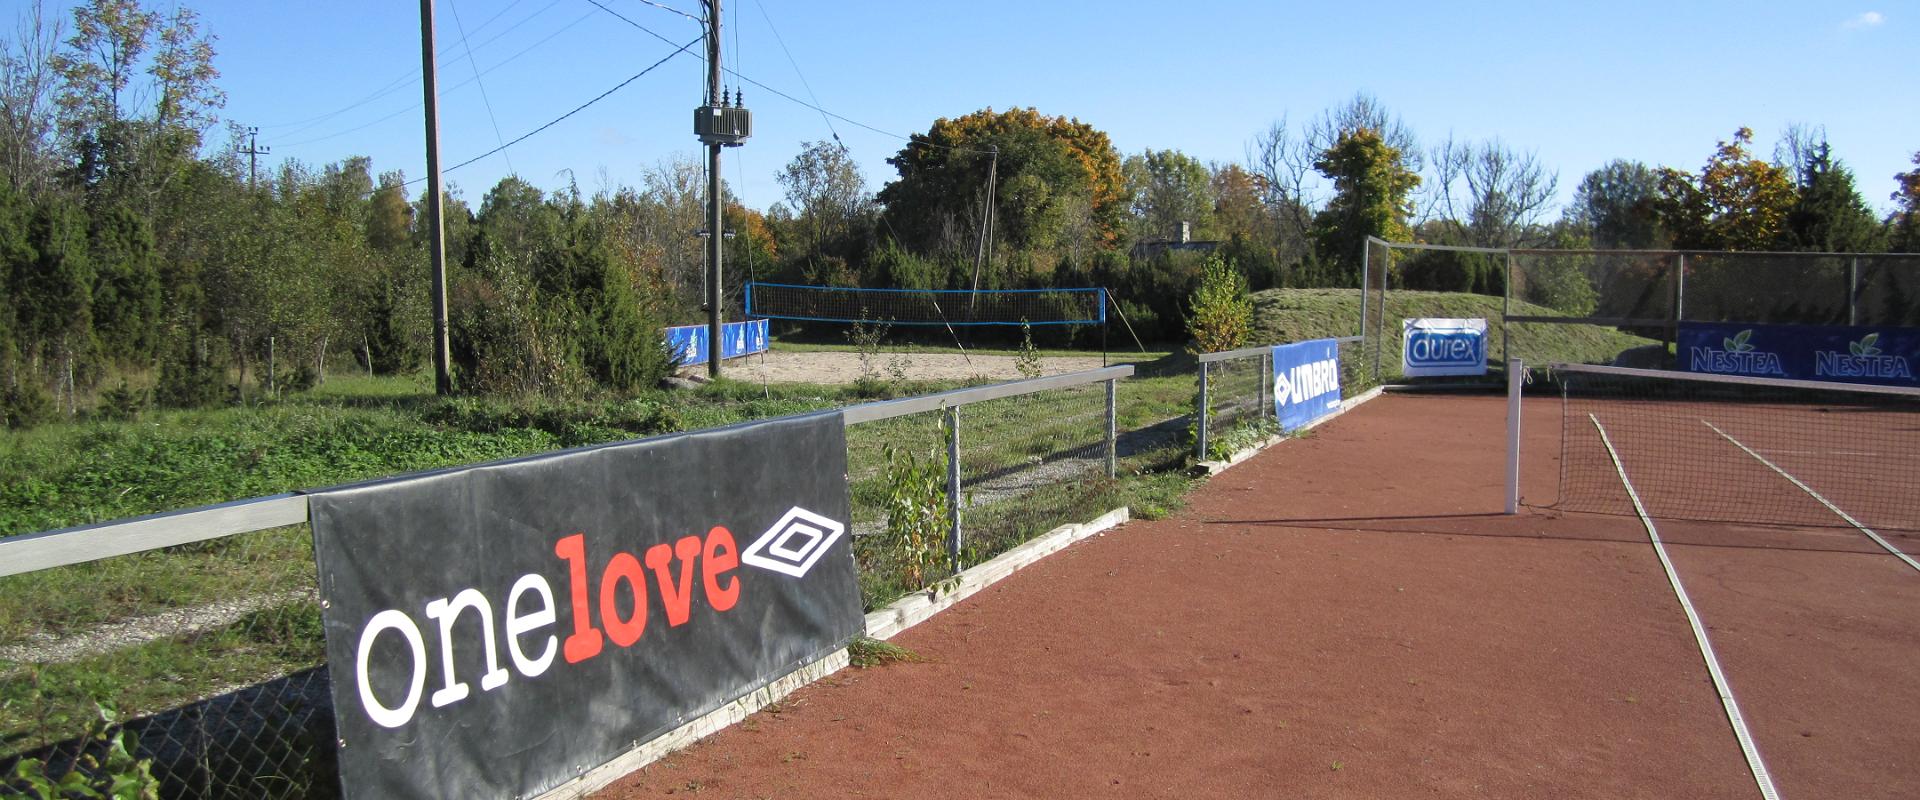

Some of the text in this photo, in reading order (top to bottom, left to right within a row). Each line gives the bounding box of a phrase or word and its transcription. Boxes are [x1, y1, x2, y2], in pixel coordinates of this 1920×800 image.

[1415, 333, 1477, 363] durex
[1691, 347, 1784, 374] NESTEA
[1815, 351, 1911, 377] NESTEA
[1290, 359, 1338, 404] UMBRO
